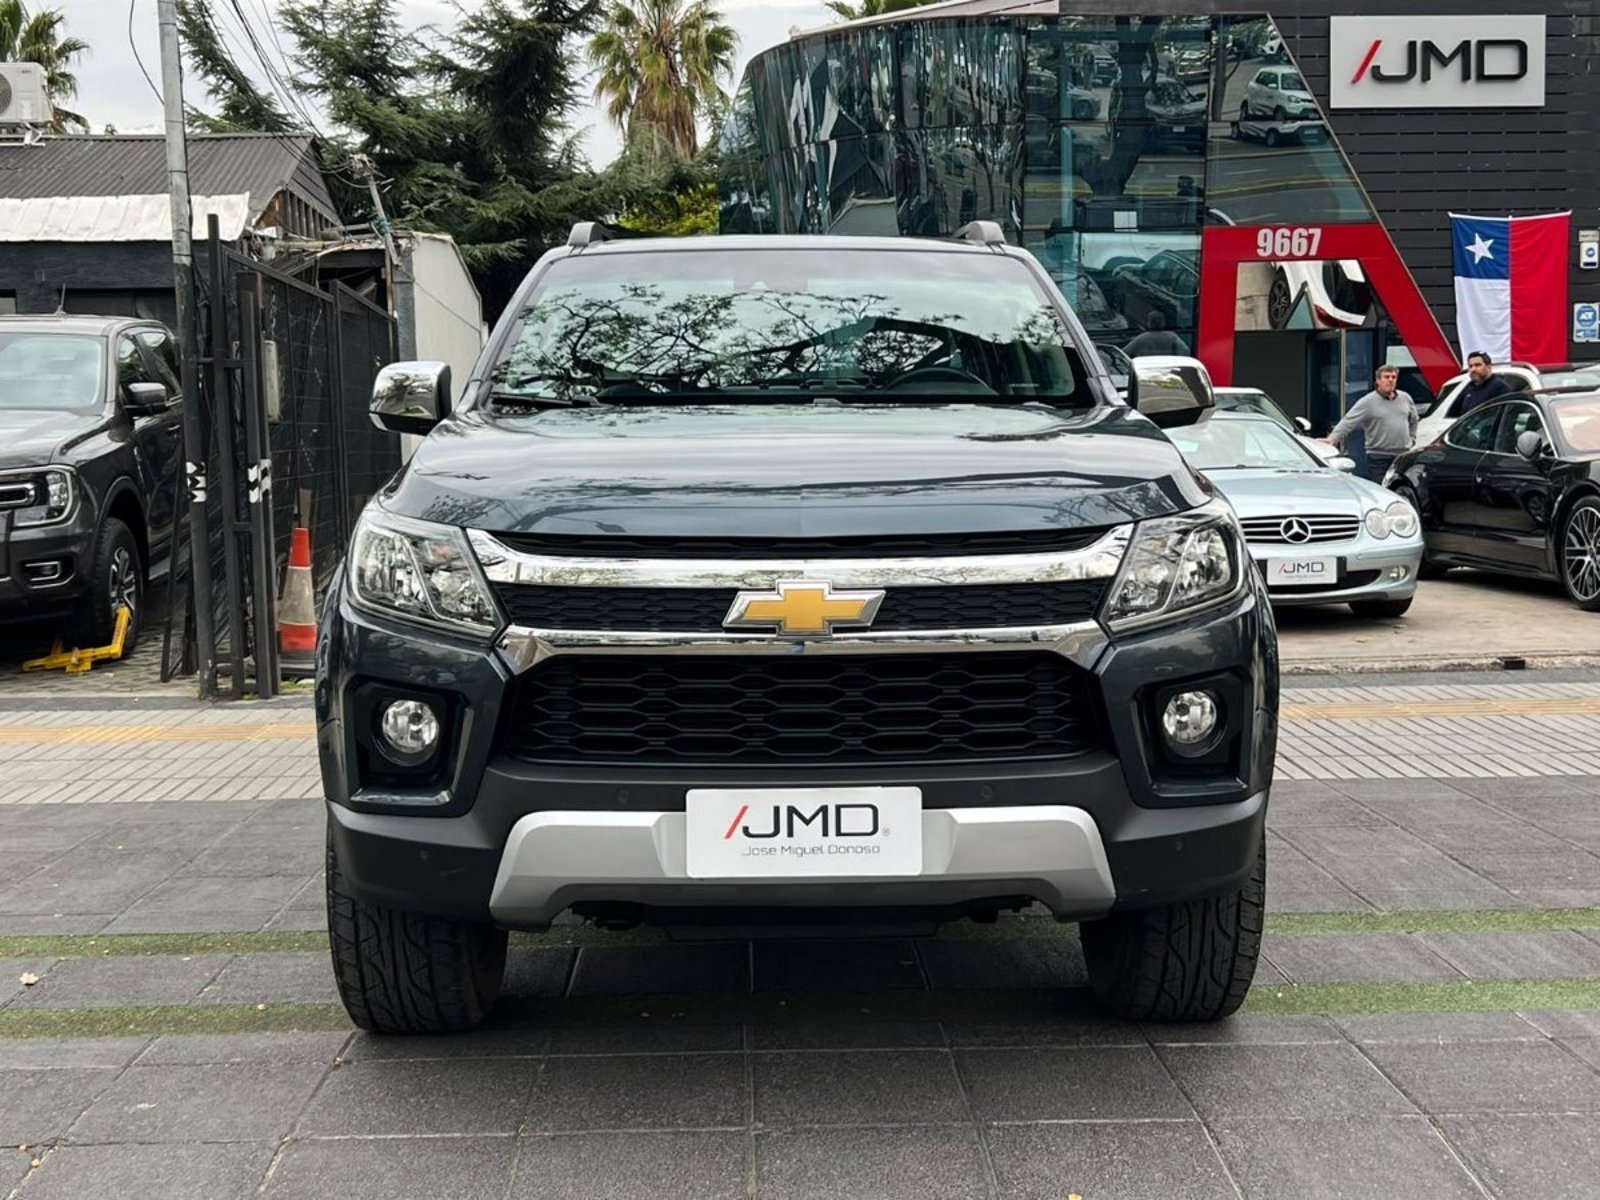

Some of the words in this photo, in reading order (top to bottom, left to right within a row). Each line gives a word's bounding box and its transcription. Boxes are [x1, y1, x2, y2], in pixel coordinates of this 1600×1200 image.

[1257, 228, 1322, 257] 9667
[741, 845, 777, 857] Jose
[780, 844, 824, 858] Miguel
[827, 844, 881, 856] Donoso
